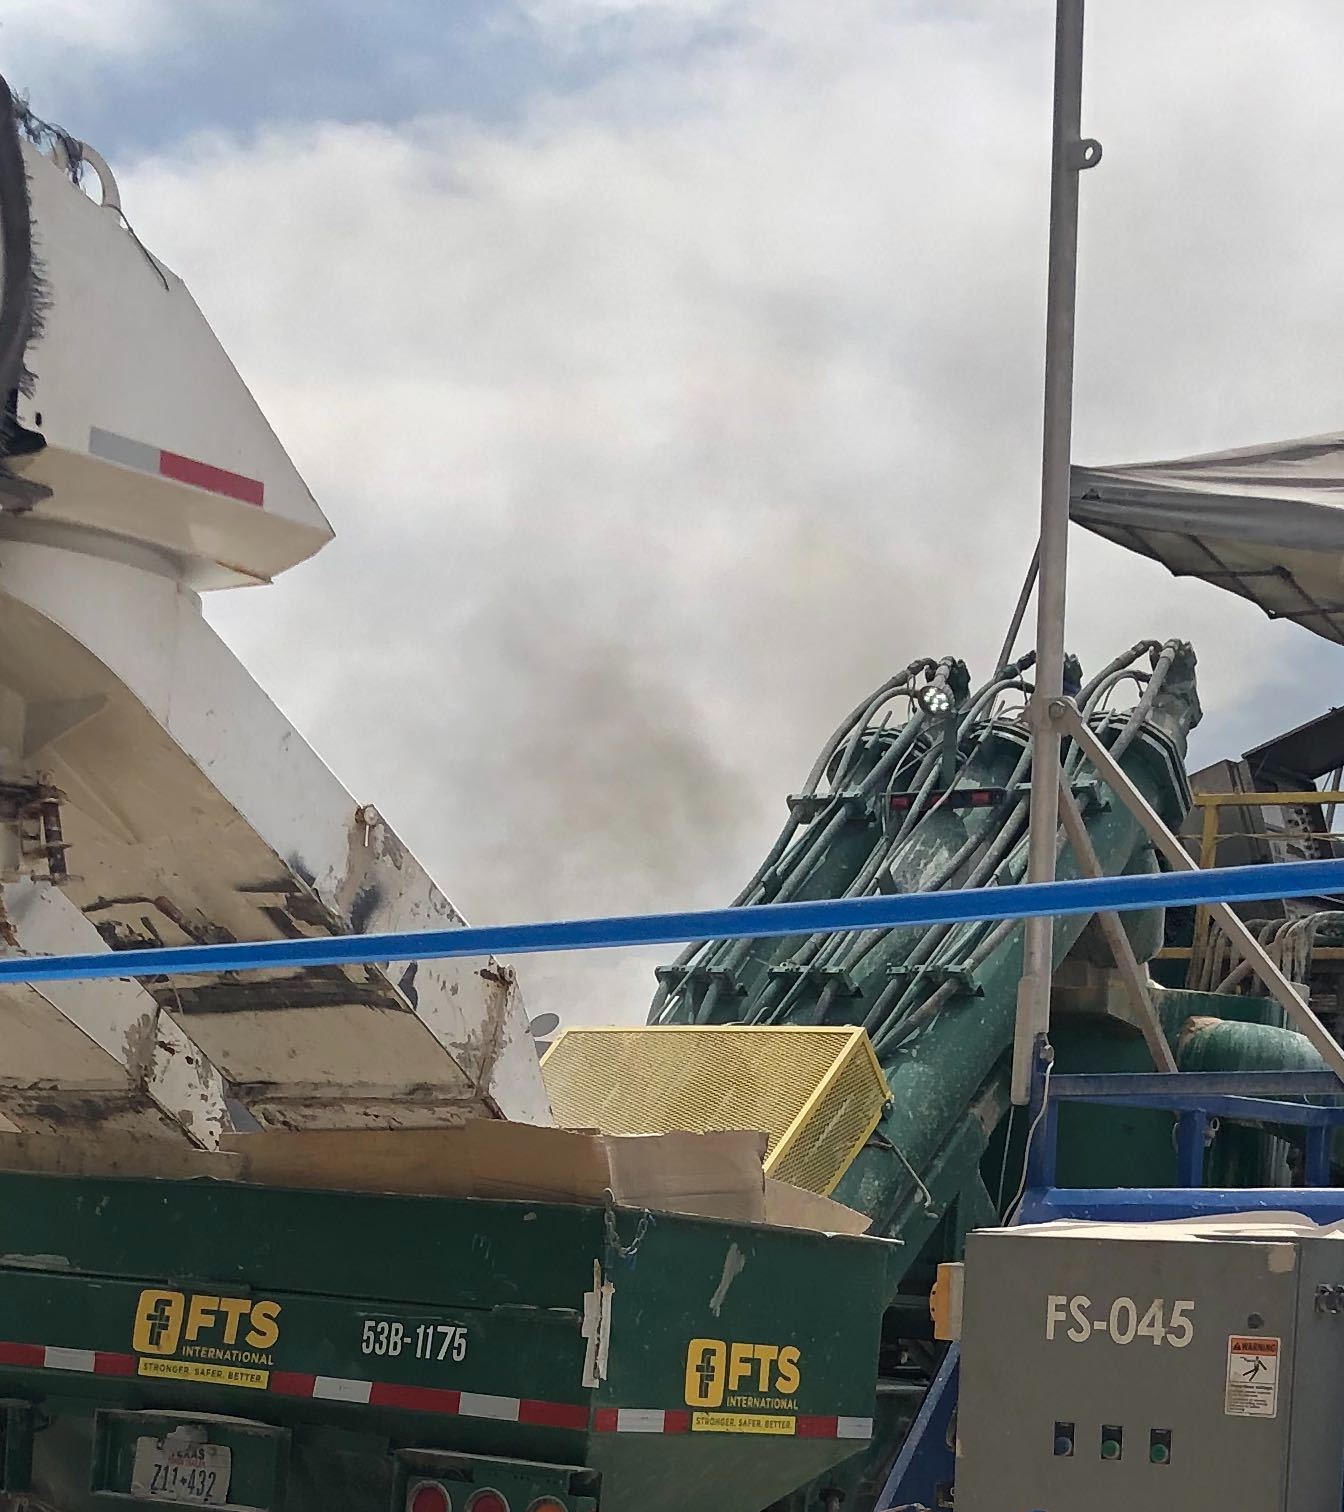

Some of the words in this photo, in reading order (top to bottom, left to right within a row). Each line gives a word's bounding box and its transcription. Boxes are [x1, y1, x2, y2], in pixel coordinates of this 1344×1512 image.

[185, 1294, 283, 1349] FTS
[361, 1320, 468, 1362] 53B-1175
[1046, 1295, 1195, 1348] FS-045
[182, 1345, 275, 1366] INTERNATIONAL
[728, 1342, 801, 1394] FTS
[1242, 1342, 1276, 1352] WARNING
[726, 1396, 799, 1411] INTERNATIONAL
